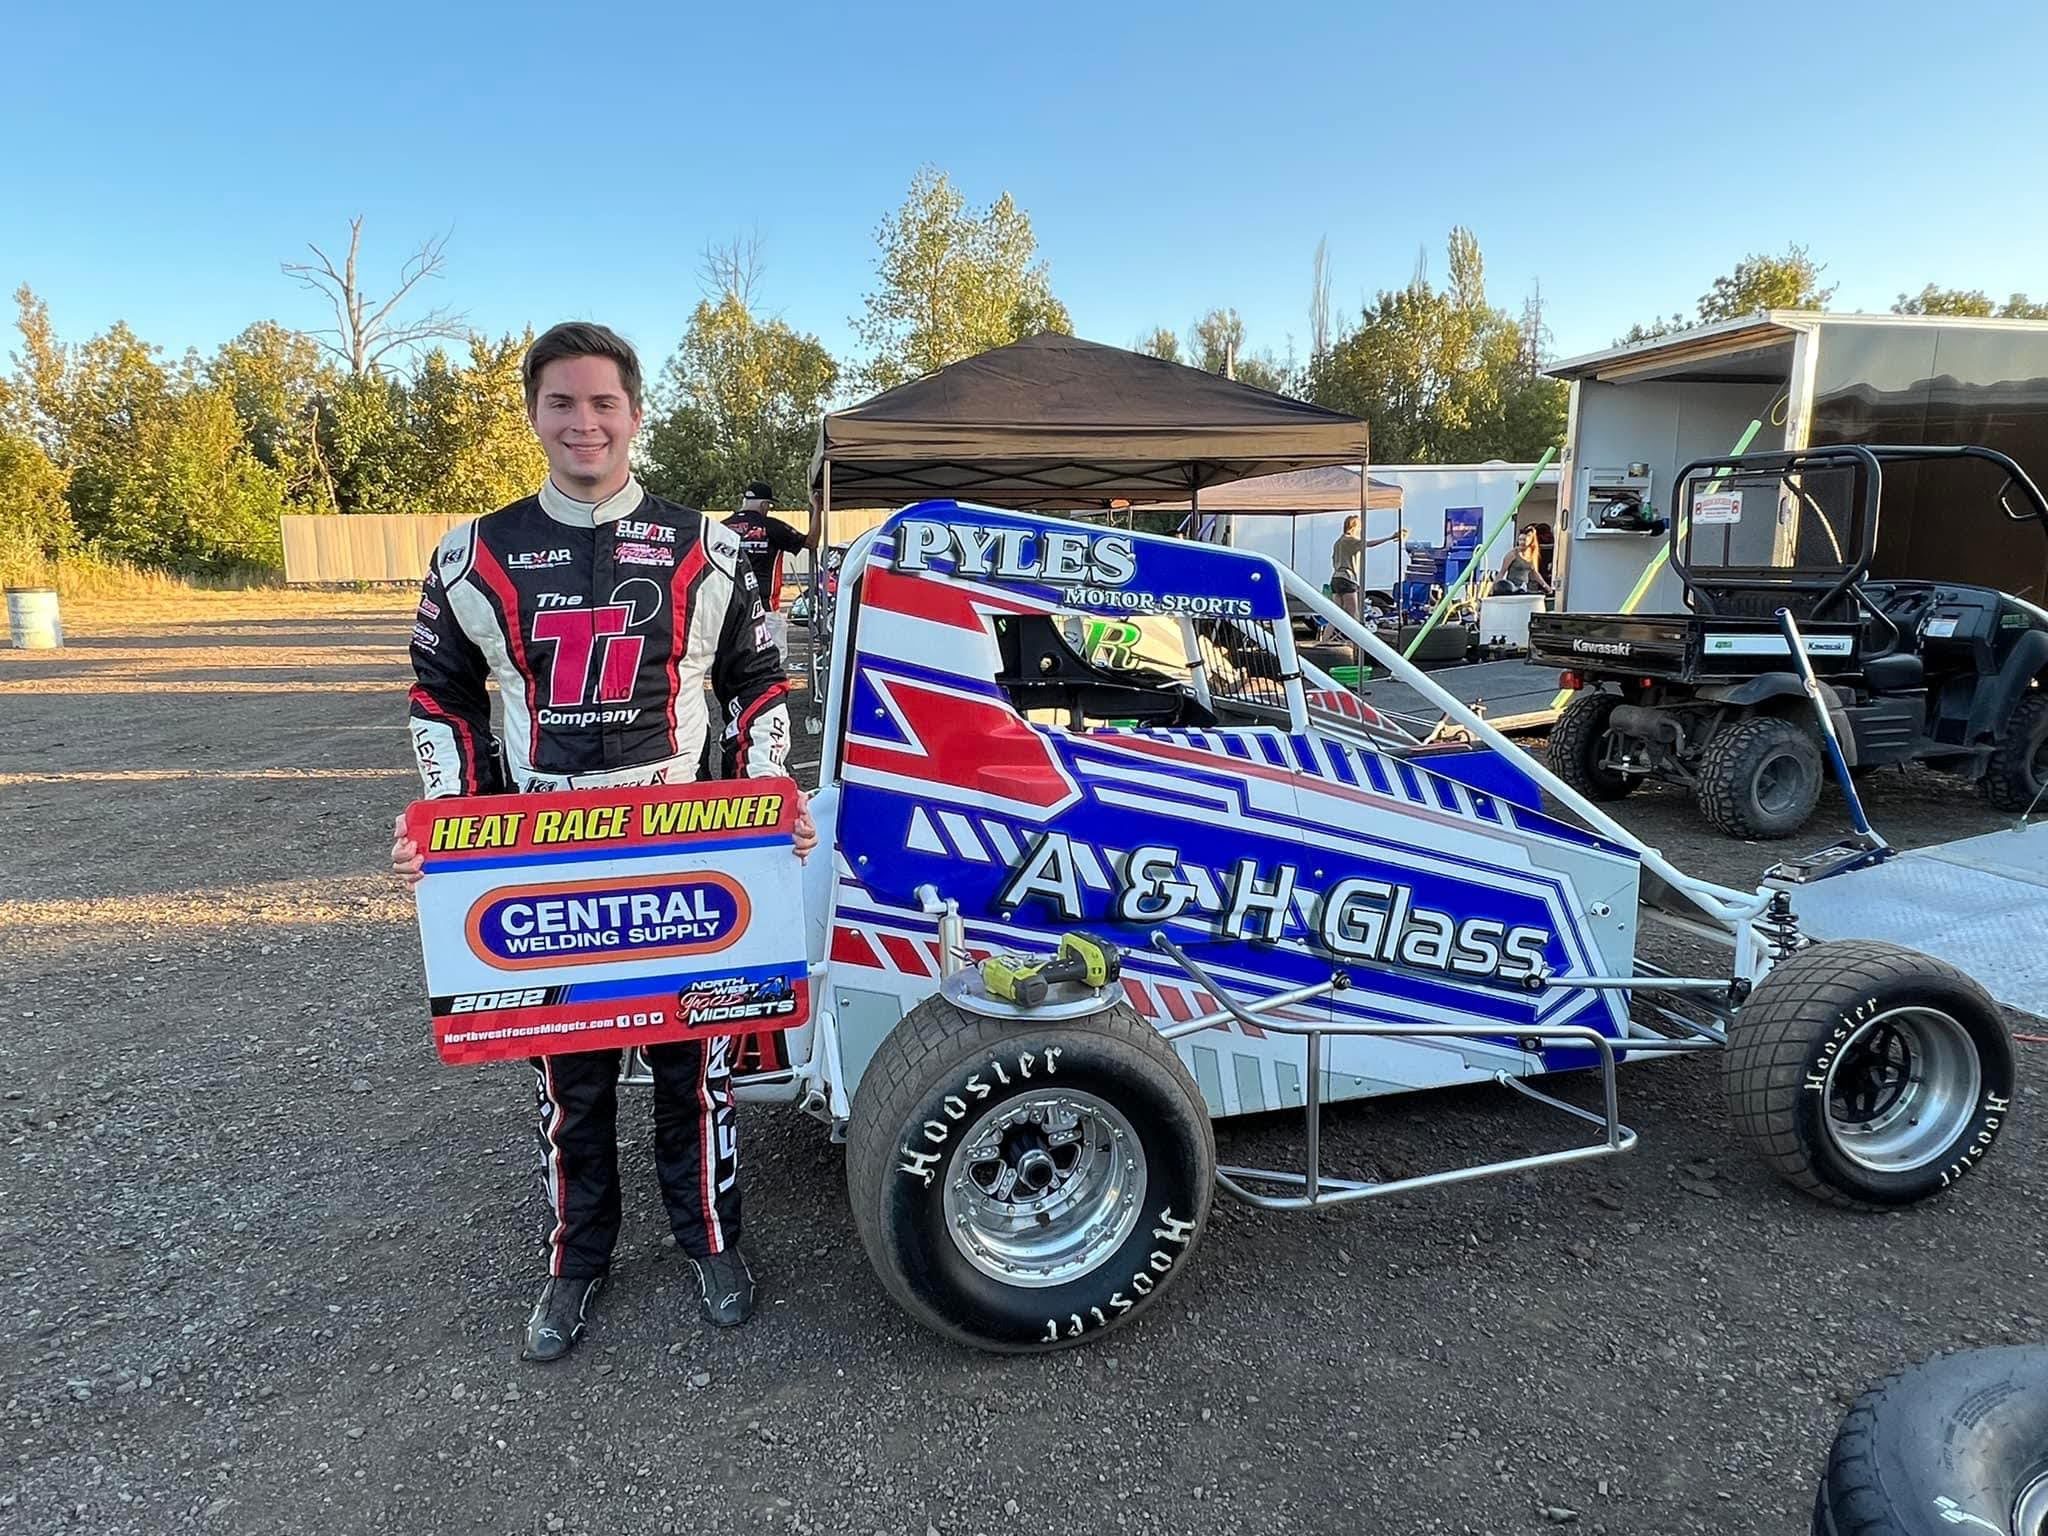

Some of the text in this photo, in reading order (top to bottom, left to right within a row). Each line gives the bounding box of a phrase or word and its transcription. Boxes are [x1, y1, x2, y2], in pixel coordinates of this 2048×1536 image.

[507, 548, 573, 565] LEXAR
[898, 520, 1137, 586] PYLES
[536, 593, 583, 607] The
[1573, 638, 1632, 656] Kawasaki
[537, 708, 641, 728] Company
[429, 794, 783, 852] HEAT RACE WINNER
[500, 889, 721, 937] CENTRAL
[1000, 831, 1551, 980] A & H Glass
[505, 921, 720, 954] WELDING SUPPLY
[691, 977, 745, 991] NORTH
[713, 983, 759, 995] WEST
[450, 989, 547, 1014] 2022
[688, 1000, 795, 1025] MIDGETS
[444, 1018, 615, 1044] NorthwestFocusMidgets.com
[1804, 997, 1877, 1096] Hoosier
[897, 1045, 1063, 1189] Hoosier
[1941, 1091, 2009, 1187] Hoosier
[1039, 1206, 1197, 1344] Hoosier
